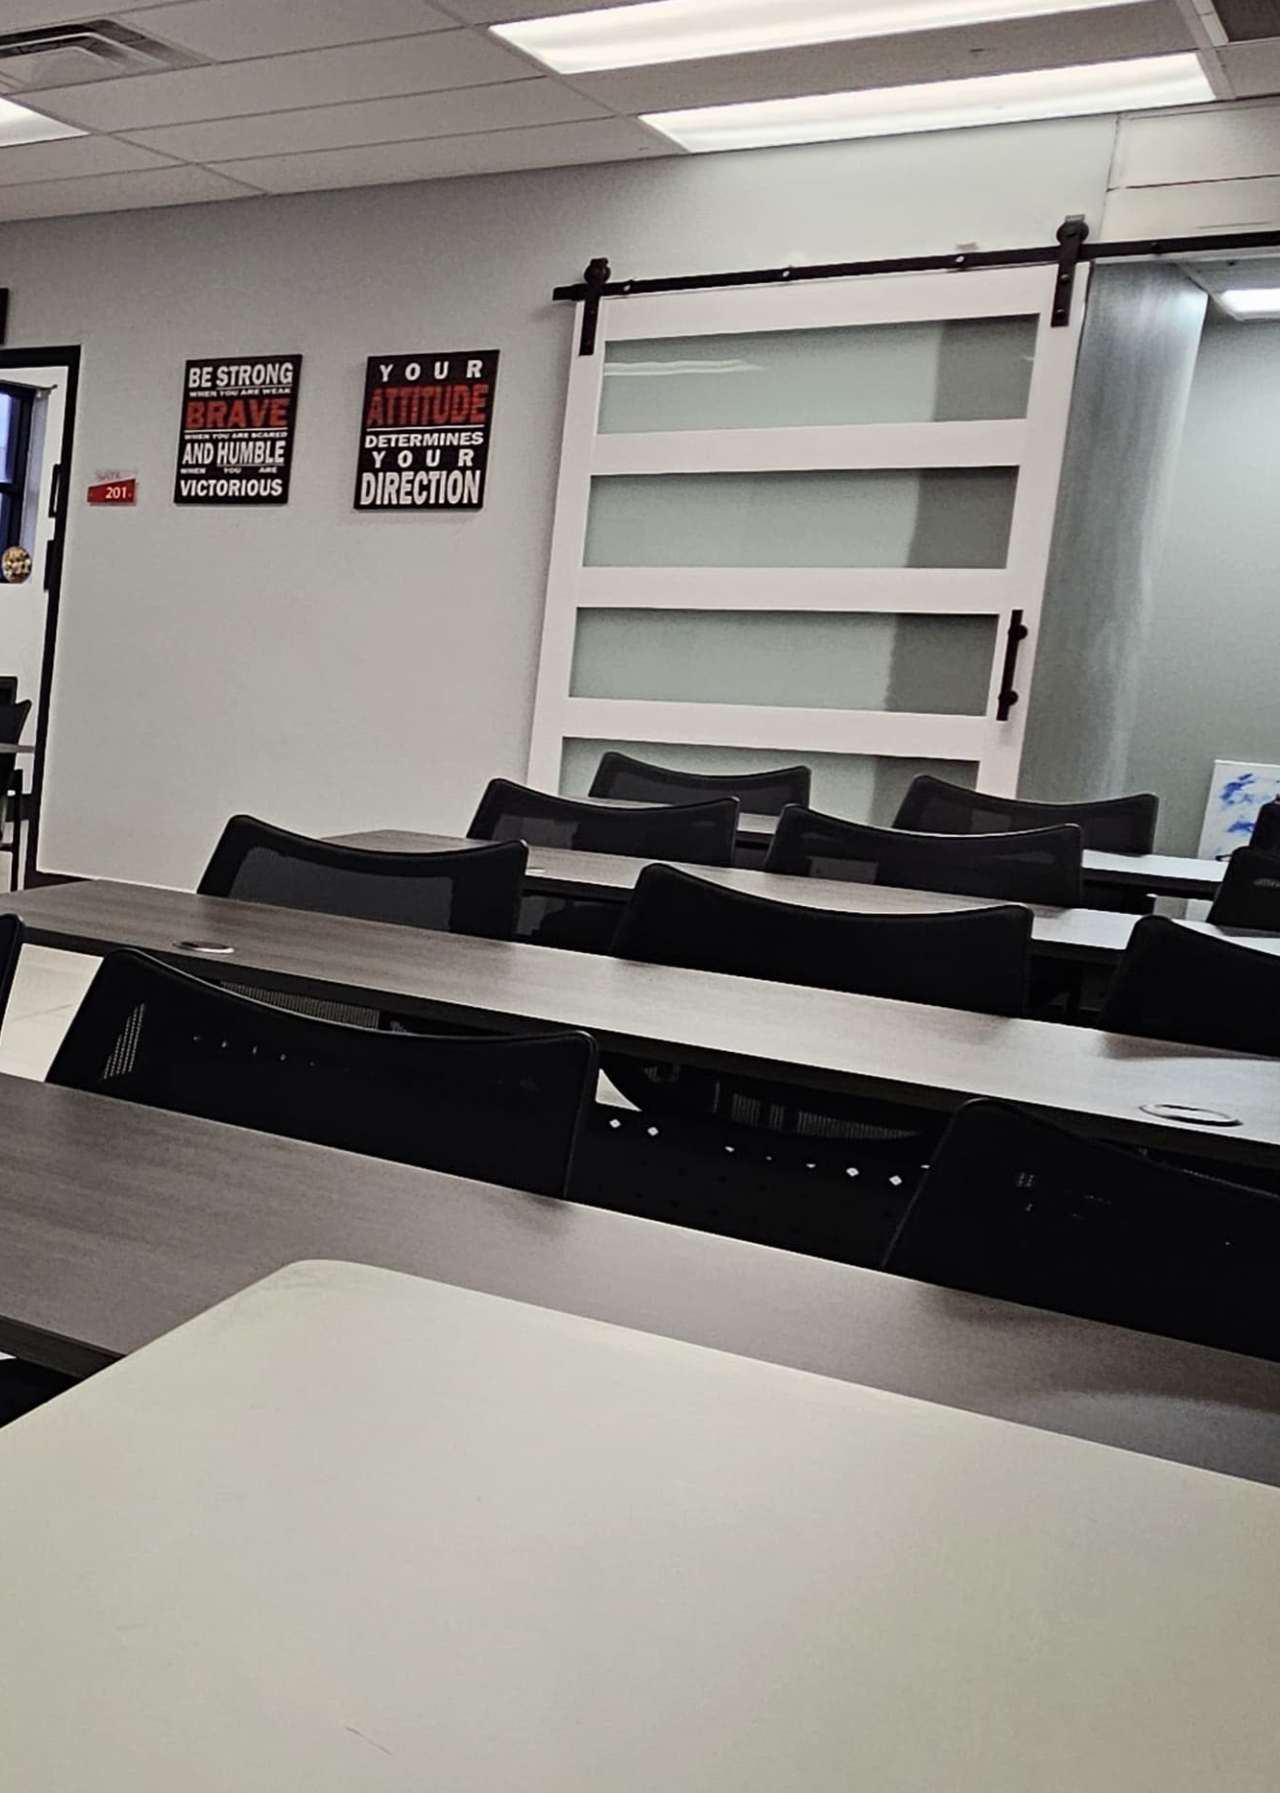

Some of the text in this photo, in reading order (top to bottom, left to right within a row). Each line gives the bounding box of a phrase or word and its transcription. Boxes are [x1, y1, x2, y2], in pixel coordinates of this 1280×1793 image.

[188, 362, 294, 388] BE STRONG
[379, 359, 483, 382] YOUR
[185, 397, 289, 428] BRAVE
[366, 383, 488, 426] ATTITUDE
[365, 431, 483, 449] DETERMINES
[182, 440, 286, 464] AND HUMBLE
[372, 448, 474, 468] YOUR
[105, 486, 127, 499] 201
[180, 478, 282, 496] VICTORIOUS
[360, 470, 481, 505] DIRECTION
